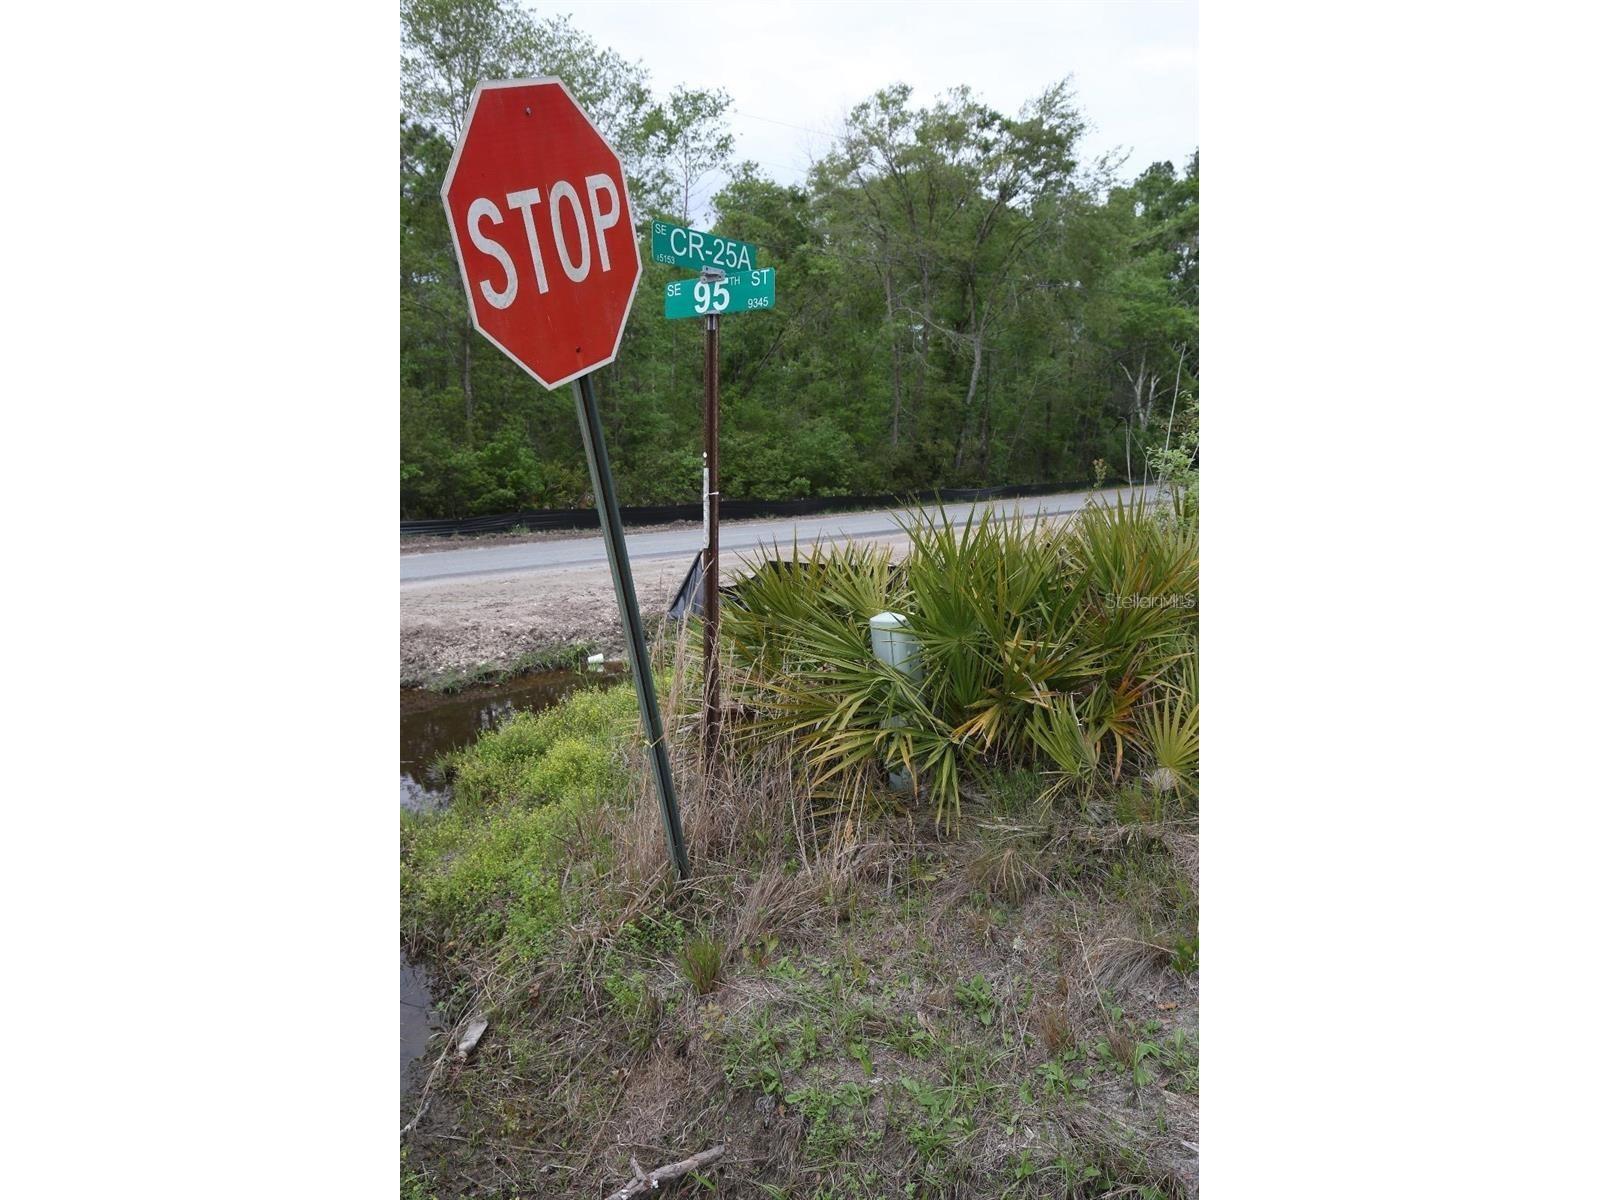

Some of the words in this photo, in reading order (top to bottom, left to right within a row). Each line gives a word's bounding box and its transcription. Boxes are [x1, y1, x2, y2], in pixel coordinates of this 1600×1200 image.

[467, 173, 621, 310] STOP
[655, 223, 667, 236] SE
[670, 228, 752, 271] CR-25A
[667, 283, 681, 297] SE
[729, 276, 741, 286] TH
[751, 269, 770, 286] ST
[747, 296, 769, 309] 9345
